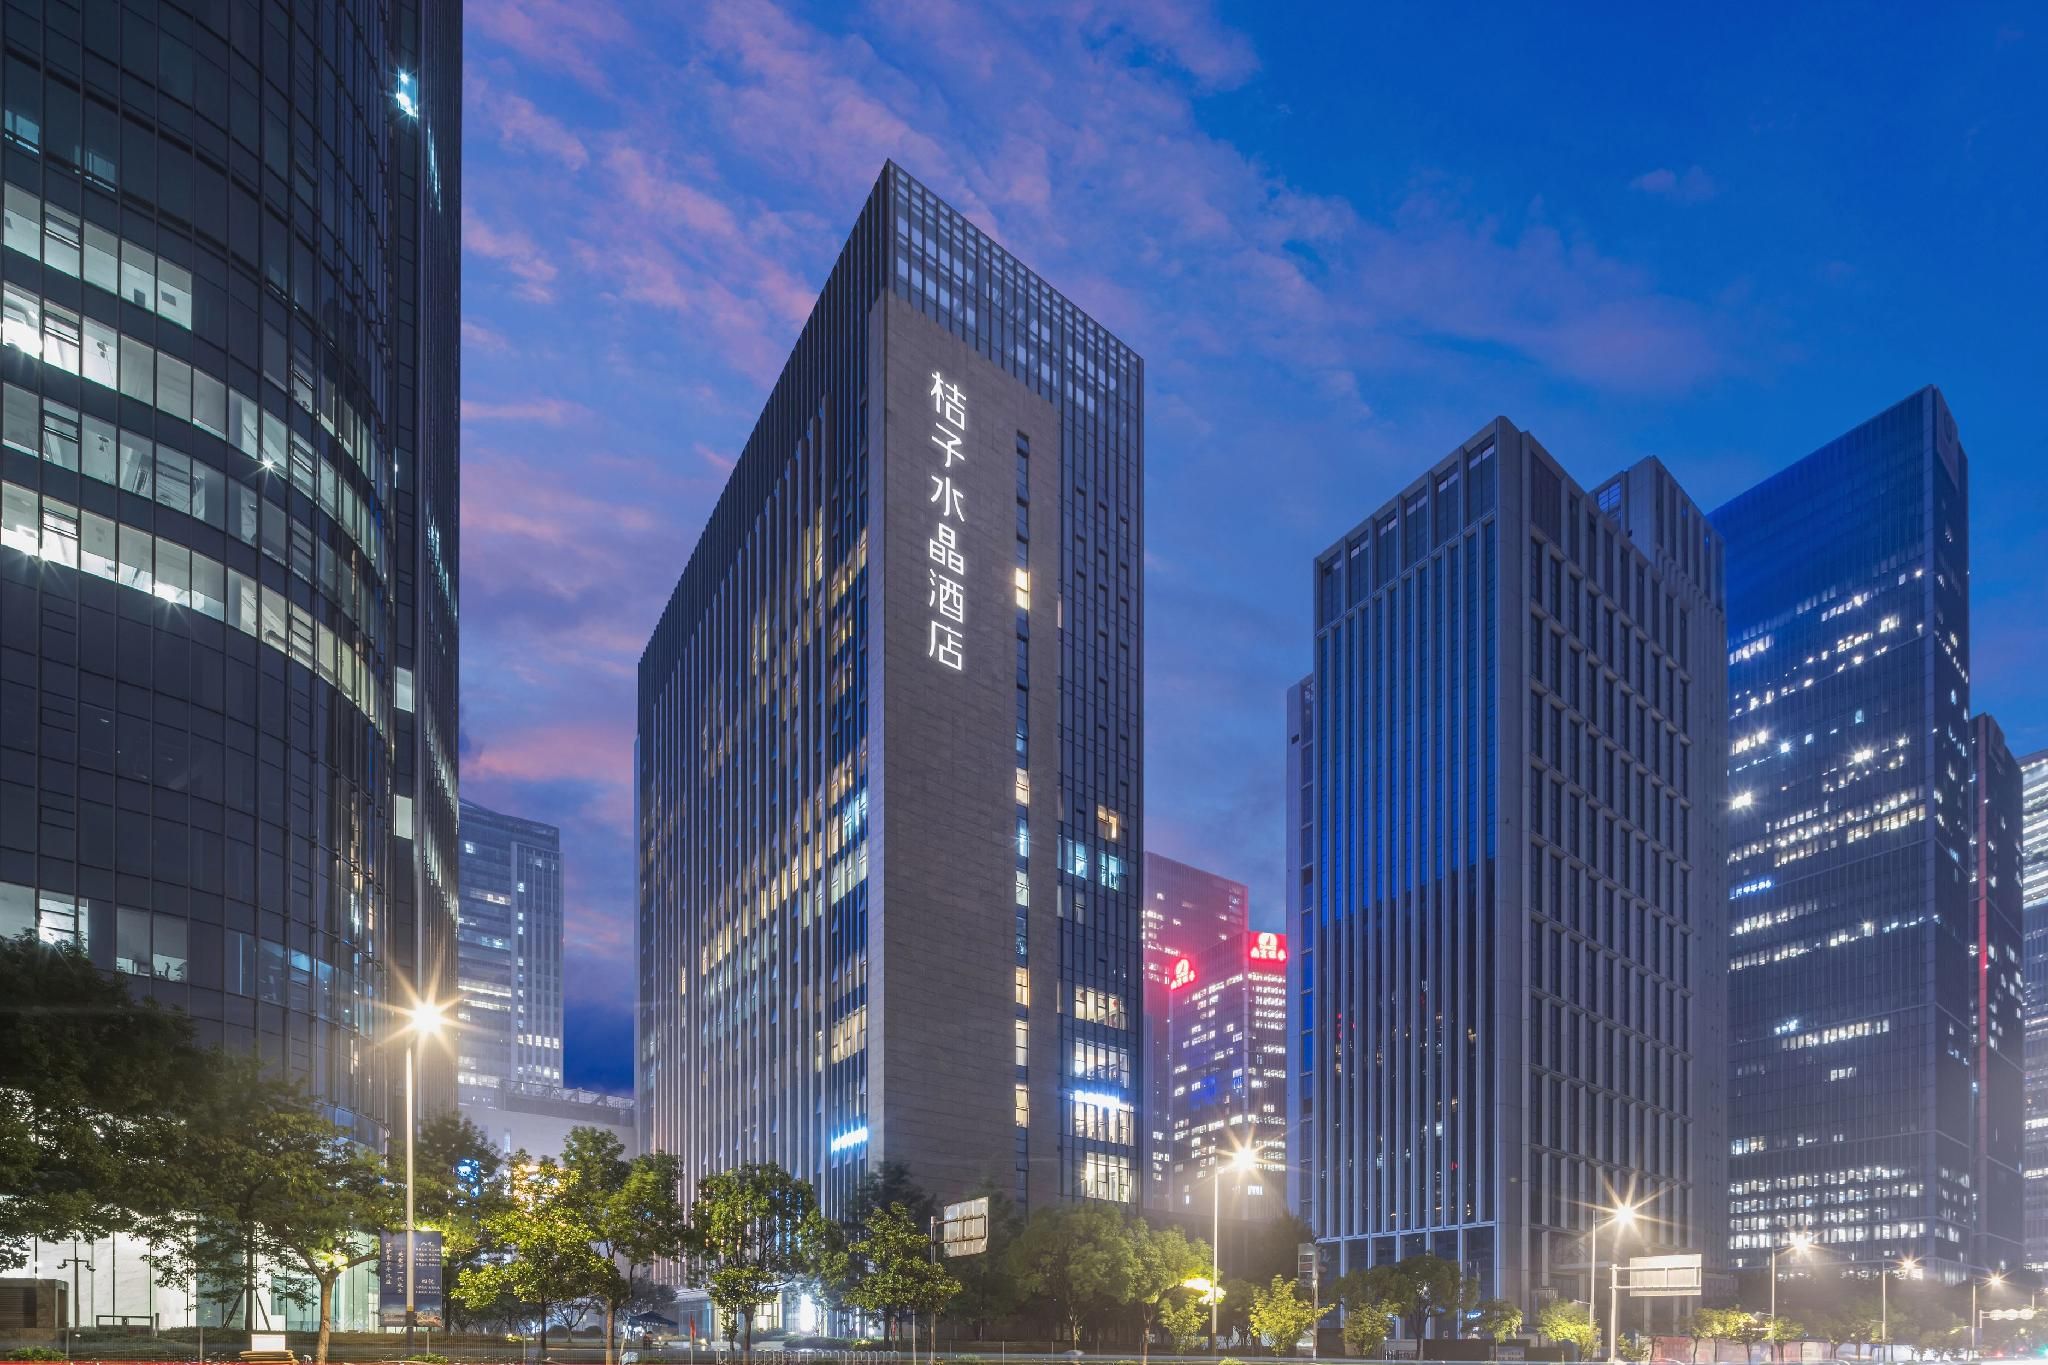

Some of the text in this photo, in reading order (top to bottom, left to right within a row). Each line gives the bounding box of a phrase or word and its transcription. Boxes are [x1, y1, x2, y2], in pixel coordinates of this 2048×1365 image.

[929, 371, 967, 672] 桔子水晶酒店
